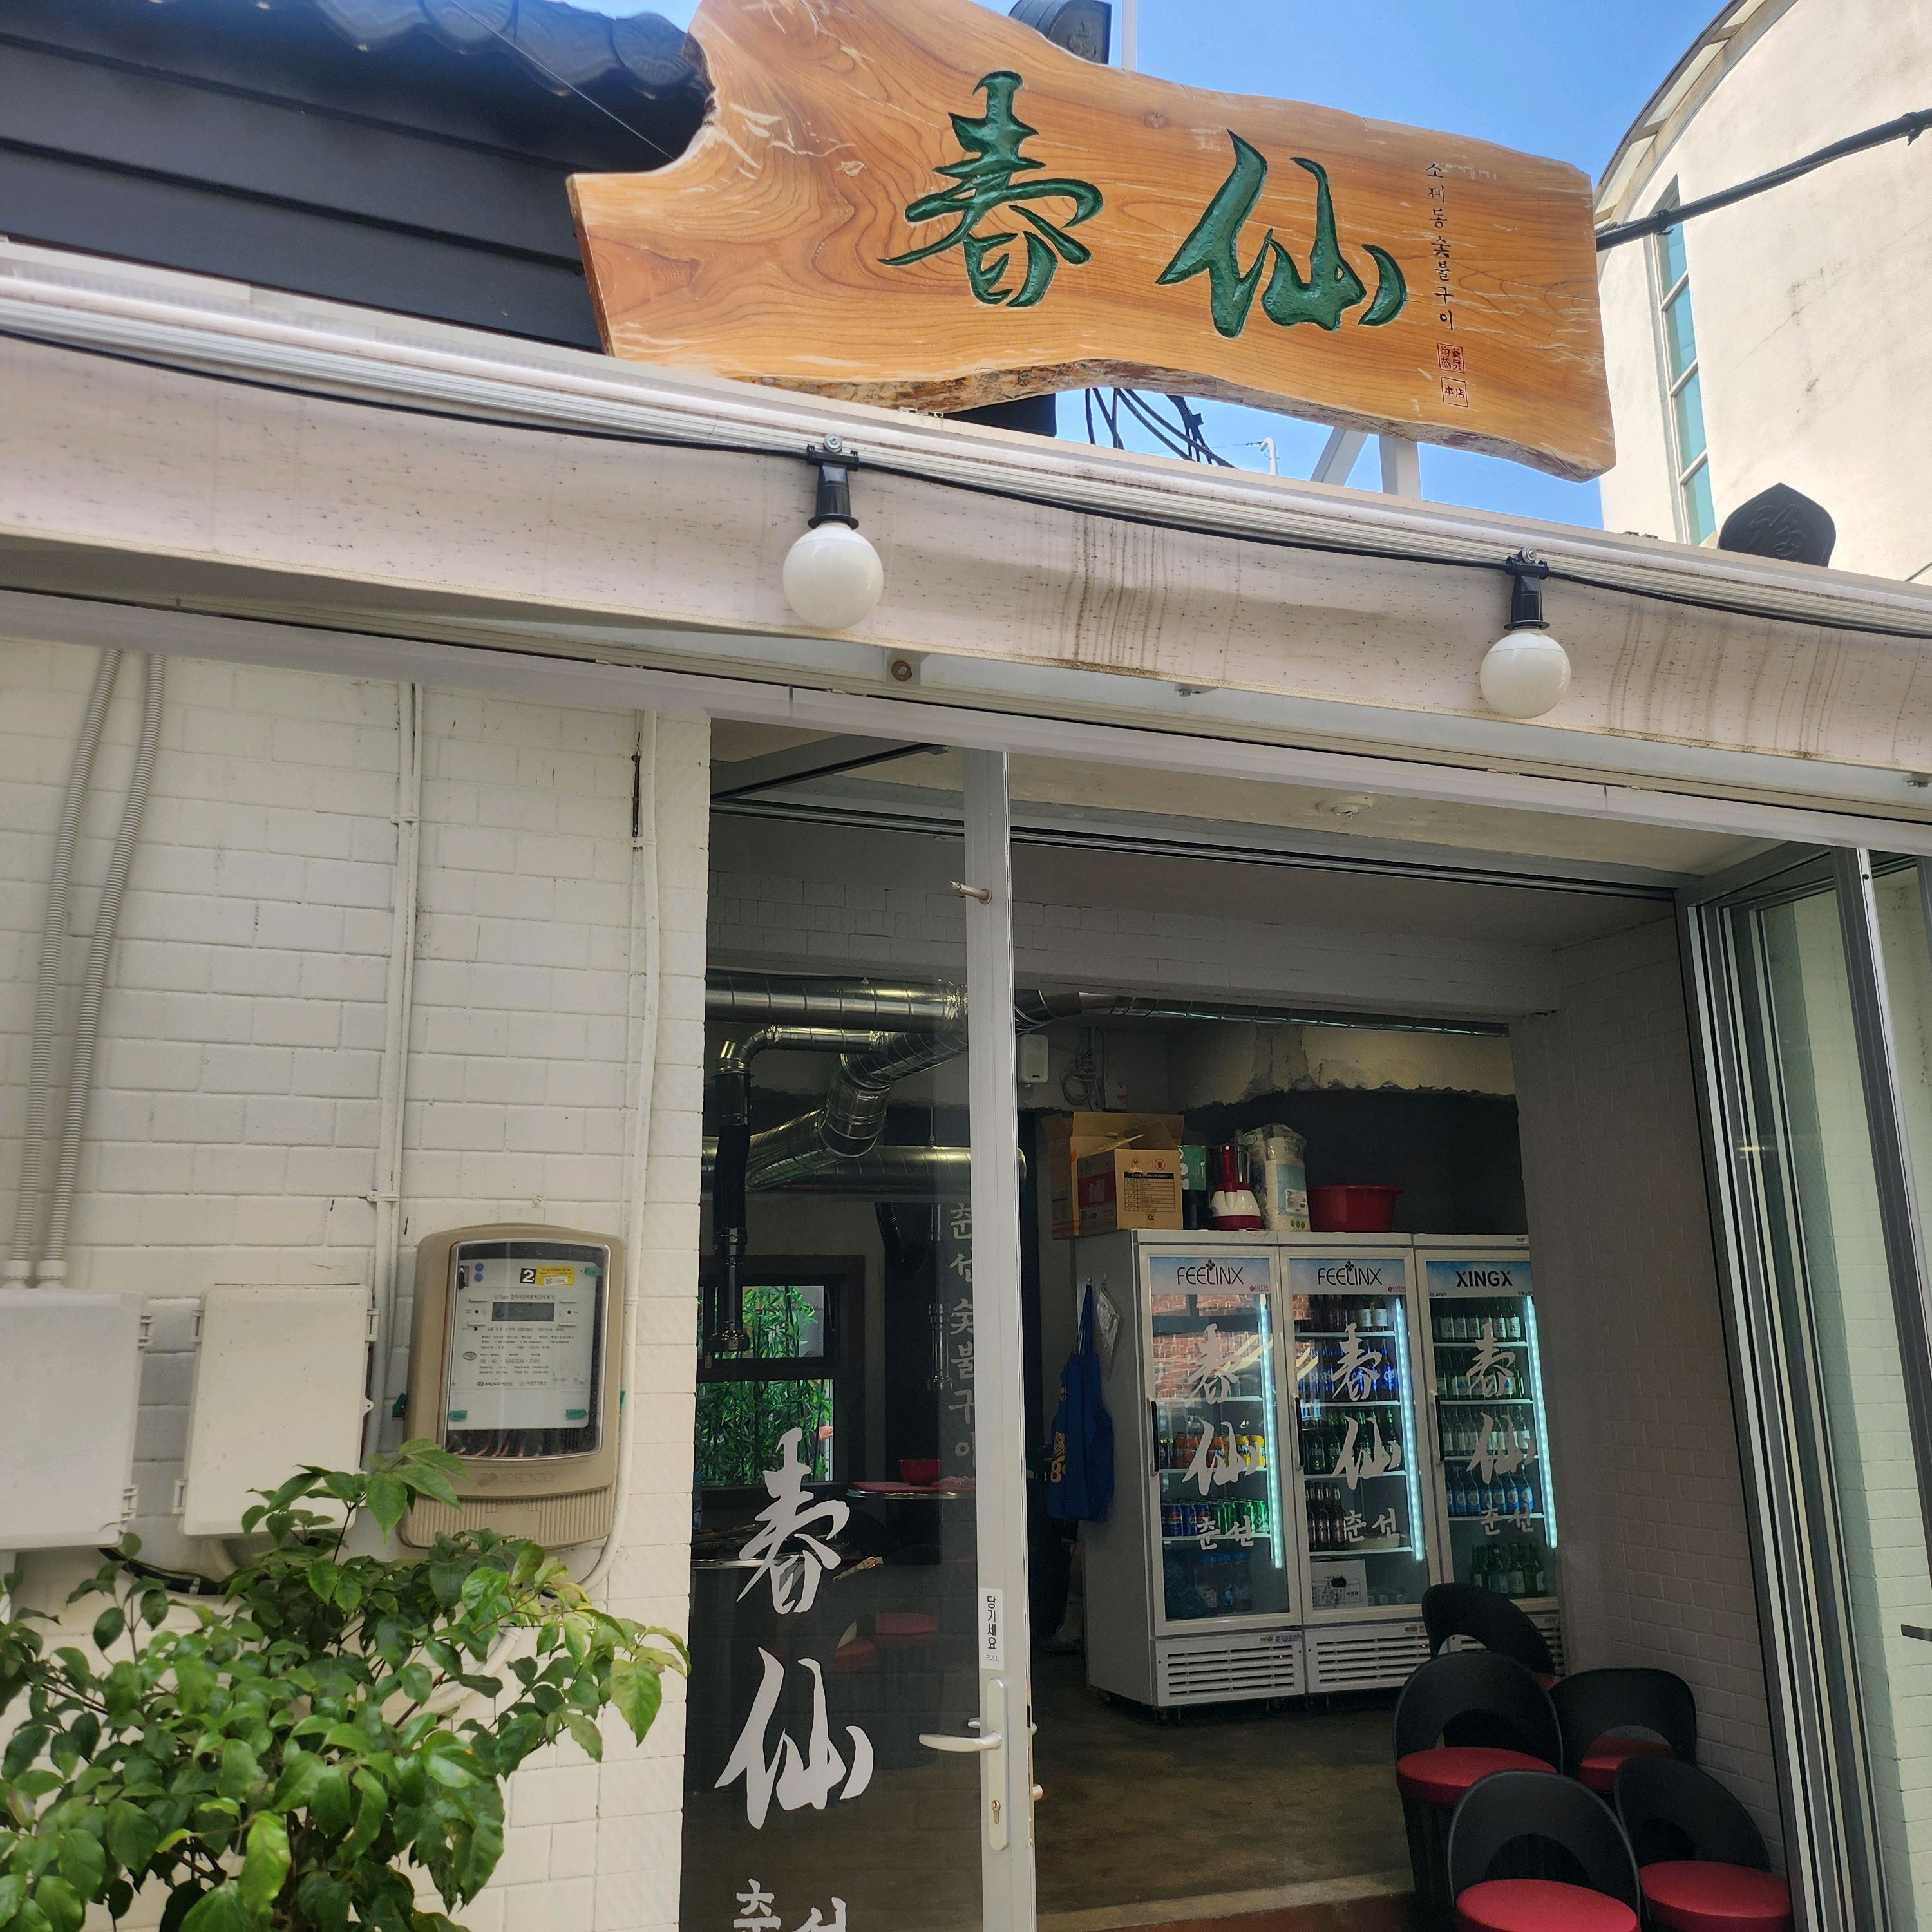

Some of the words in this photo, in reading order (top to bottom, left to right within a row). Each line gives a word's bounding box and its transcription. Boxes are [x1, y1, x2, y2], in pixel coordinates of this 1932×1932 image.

[877, 70, 1407, 339] 春仙
[1425, 162, 1448, 229] 소제동
[1430, 235, 1455, 331] 숯불구이
[1444, 385, 1465, 399] 本店
[1177, 1267, 1244, 1285] FEELINX
[1318, 1267, 1383, 1286] FEELINX
[1455, 1270, 1513, 1287] XINGX
[1331, 1322, 1402, 1490] 春仙
[1466, 1321, 1536, 1484] 春仙
[1197, 1515, 1254, 1550] 춘선
[1343, 1508, 1400, 1542] 춘선
[714, 1427, 875, 1830] 春仙
[987, 1595, 997, 1650] 당기세요
